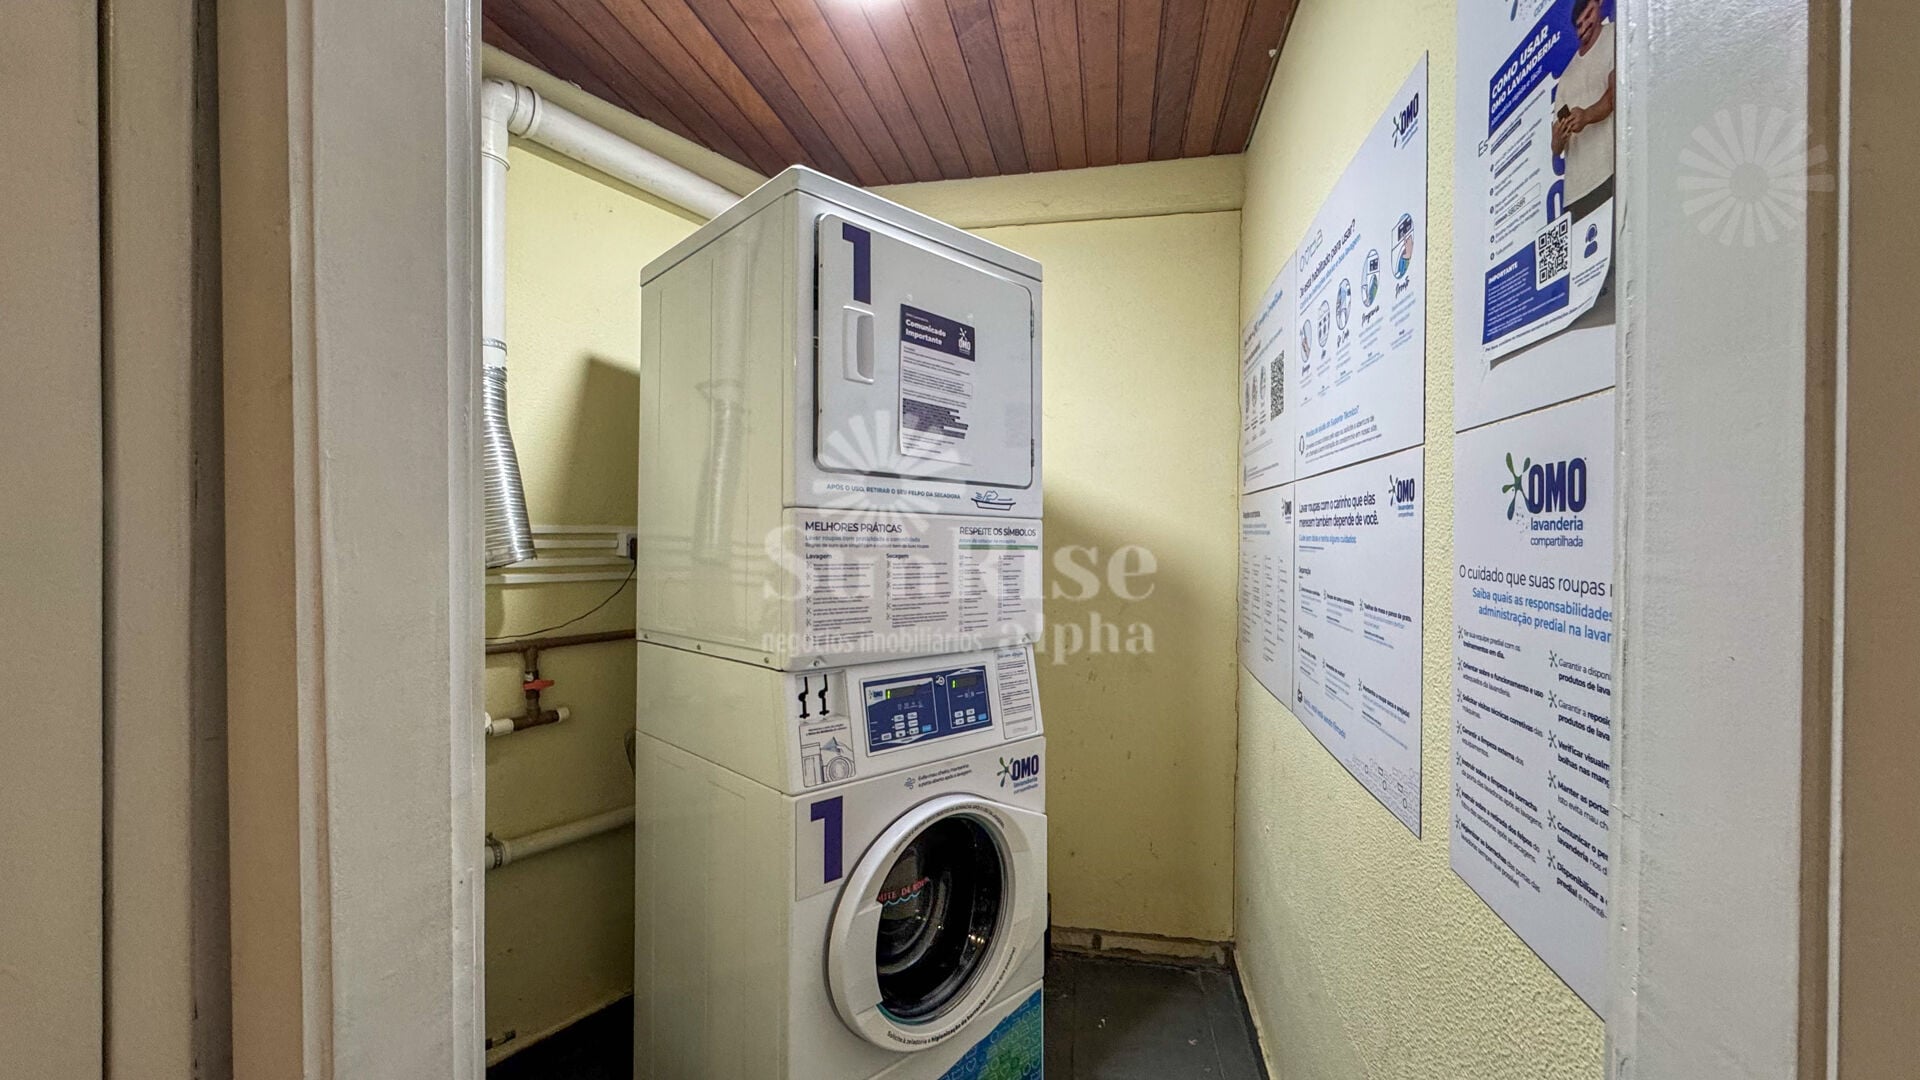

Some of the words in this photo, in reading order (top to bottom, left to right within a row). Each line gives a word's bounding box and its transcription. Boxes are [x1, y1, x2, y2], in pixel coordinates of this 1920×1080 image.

[1491, 60, 1519, 99] COMO
[1520, 24, 1549, 66] USAR
[1400, 92, 1419, 136] OMO
[1491, 93, 1507, 114] OMO
[842, 222, 871, 305] 1
[1488, 261, 1518, 284] IMPORTANTE
[905, 318, 946, 337] Comunicado
[905, 328, 942, 345] Importante
[826, 483, 844, 491] APÓS
[866, 486, 891, 494] RETIRAR
[908, 489, 926, 497] FELPO
[934, 491, 961, 500] SECADORA
[1396, 478, 1415, 503] OMO
[1528, 457, 1587, 514] OMO
[1333, 495, 1351, 509] carinho
[1352, 496, 1363, 510] que
[1363, 490, 1376, 505] elas
[805, 521, 859, 533] MELHORES
[860, 521, 903, 534] PRÁTICAS
[959, 526, 992, 536] RESPEITE
[992, 527, 1003, 536] OS
[1003, 526, 1037, 537] SÍMBOLOS
[1333, 512, 1354, 530] depende
[1355, 512, 1362, 526] de
[1363, 510, 1379, 526] você.
[1530, 516, 1584, 531] lavanderia
[1530, 535, 1584, 548] compartilhada
[805, 553, 832, 561] Lavagem
[1459, 564, 1466, 578] O
[1467, 565, 1504, 584] cuidado
[1505, 572, 1527, 588] que
[1528, 573, 1555, 590] suas
[1558, 577, 1606, 598] roupas
[1472, 586, 1491, 600] Saiba
[1492, 591, 1512, 605] quais
[1514, 596, 1523, 606] as
[1478, 604, 1532, 627] administração
[1534, 616, 1566, 633] predial
[1568, 624, 1581, 637] na
[1489, 637, 1504, 647] predial
[1558, 658, 1582, 672] Garantir
[1582, 666, 1587, 674] a
[1463, 661, 1478, 673] Orientar
[1479, 668, 1490, 678] sobre
[1494, 672, 1529, 692] funcionamento
[1534, 689, 1544, 698] uso
[1558, 673, 1586, 688] produtos
[1586, 681, 1596, 691] de
[1596, 683, 1611, 696] lava
[1462, 693, 1477, 706] Solicitar
[1478, 700, 1491, 712] visitas
[1490, 706, 1509, 721] técnicas
[1509, 716, 1534, 733] corretivas
[1558, 699, 1581, 715] Garantir
[1582, 709, 1586, 717] a
[1558, 714, 1586, 731] produtos
[1586, 724, 1595, 736] de
[1596, 727, 1611, 741] lava
[1462, 725, 1477, 739] Garantir
[1481, 735, 1497, 750] limpeza
[1497, 746, 1515, 761] externa
[1515, 755, 1524, 766] dos
[1557, 739, 1583, 759] Verificar
[1011, 754, 1039, 781] OMO
[1557, 752, 1578, 771] bolhas
[1578, 765, 1590, 777] nas
[1475, 767, 1487, 779] sobre
[1490, 775, 1508, 793] limpeza
[1508, 788, 1515, 797] da
[1515, 791, 1538, 813] borracha
[1557, 780, 1580, 799] Manter
[1580, 794, 1588, 804] as
[1588, 799, 1609, 817] portas
[1490, 812, 1508, 829] retirada
[1507, 824, 1517, 836] dos
[1568, 802, 1583, 816] evita
[1583, 811, 1598, 825] mau
[810, 795, 843, 884] 1
[1557, 821, 1591, 849] Comunicar
[1591, 845, 1597, 853] o
[1485, 841, 1507, 865] borrachas
[1557, 834, 1589, 863] lavanderia
[1589, 858, 1602, 872] nos
[1556, 861, 1599, 899] Disponibilizar
[1599, 894, 1605, 904] a
[1556, 876, 1578, 898] predial
